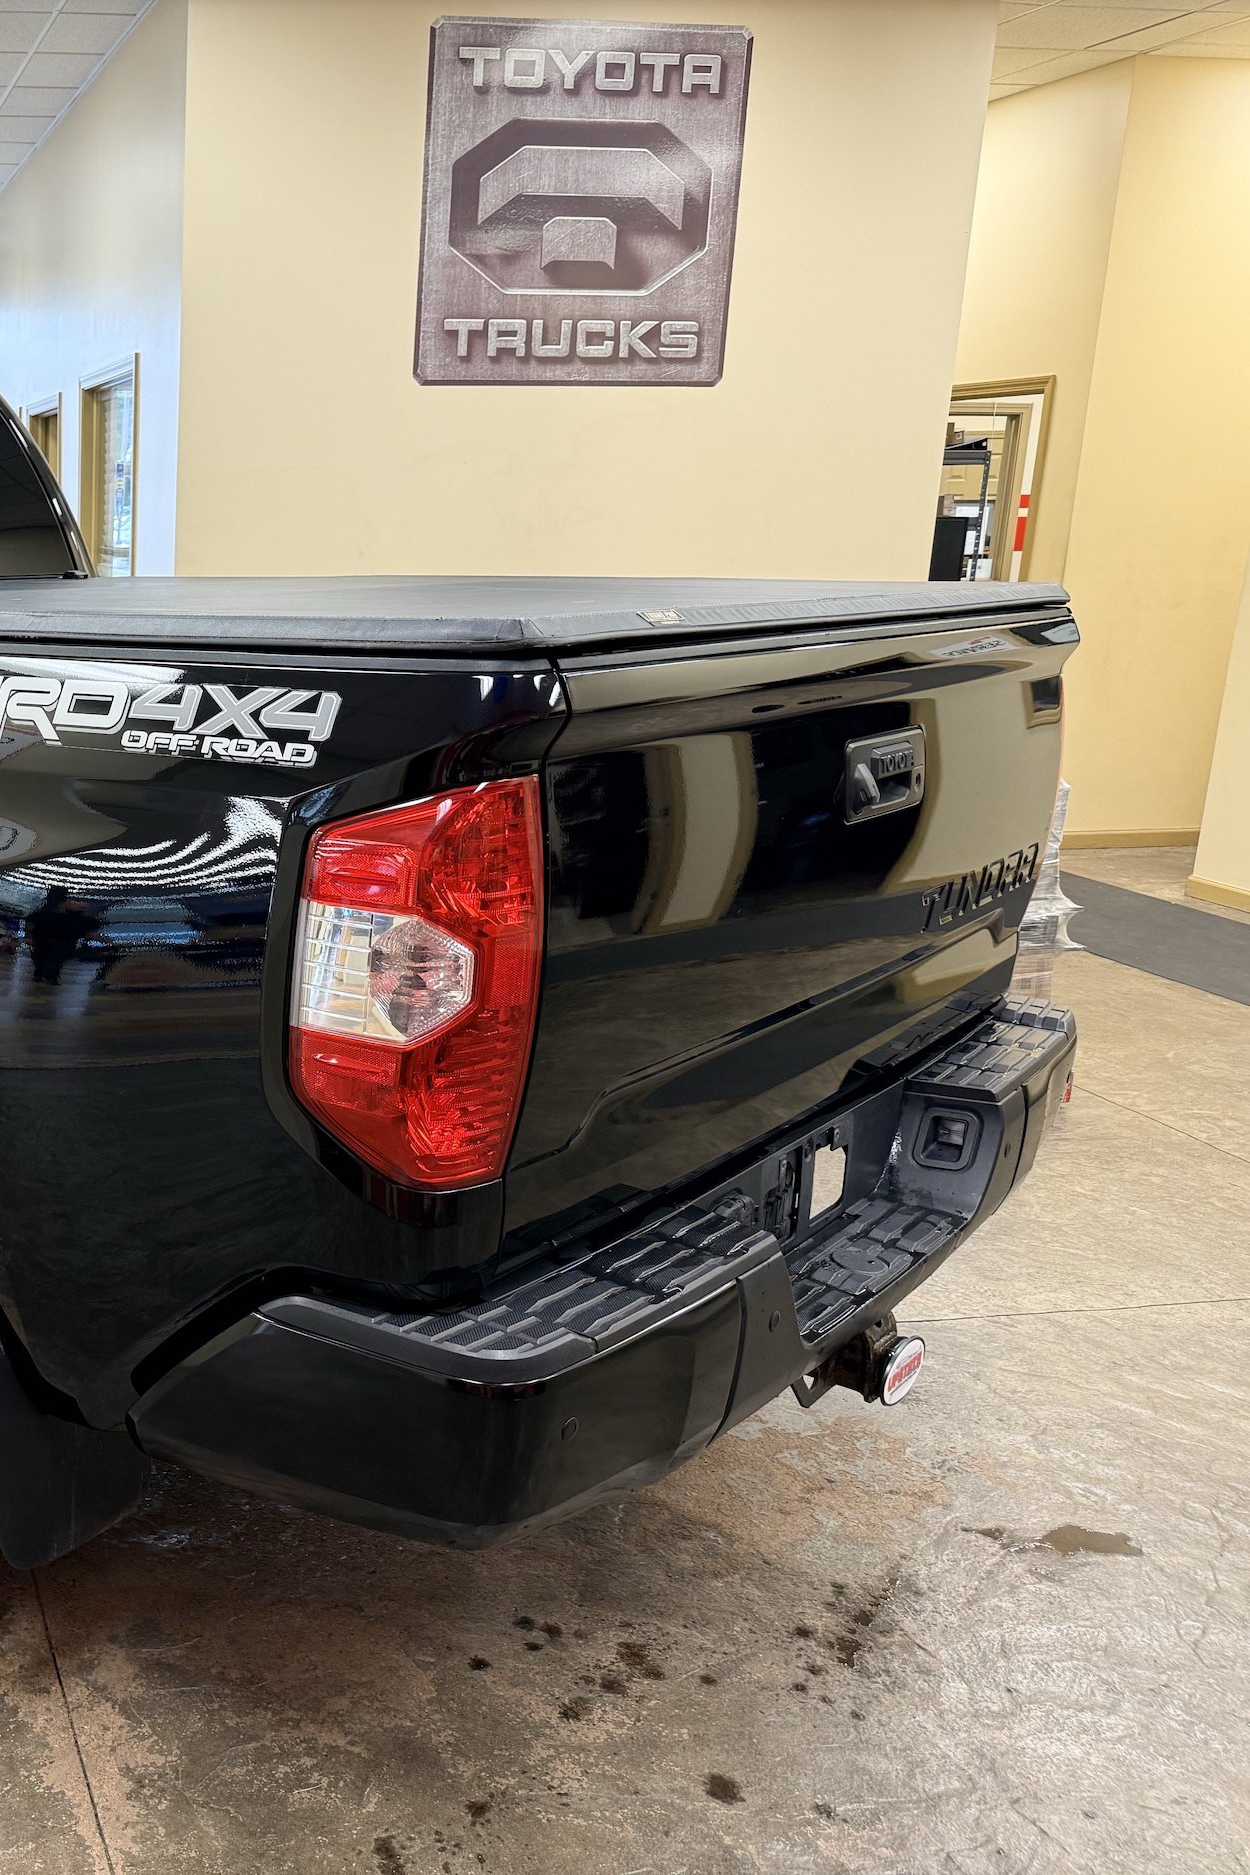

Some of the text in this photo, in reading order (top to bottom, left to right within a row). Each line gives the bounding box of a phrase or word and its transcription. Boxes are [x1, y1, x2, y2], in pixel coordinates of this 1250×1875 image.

[459, 46, 722, 94] TOYOTA
[443, 318, 700, 358] TRUCKS
[121, 729, 317, 769] OFF ROAD
[878, 749, 915, 775] TOYOTA
[920, 842, 1039, 934] TUNDRA
